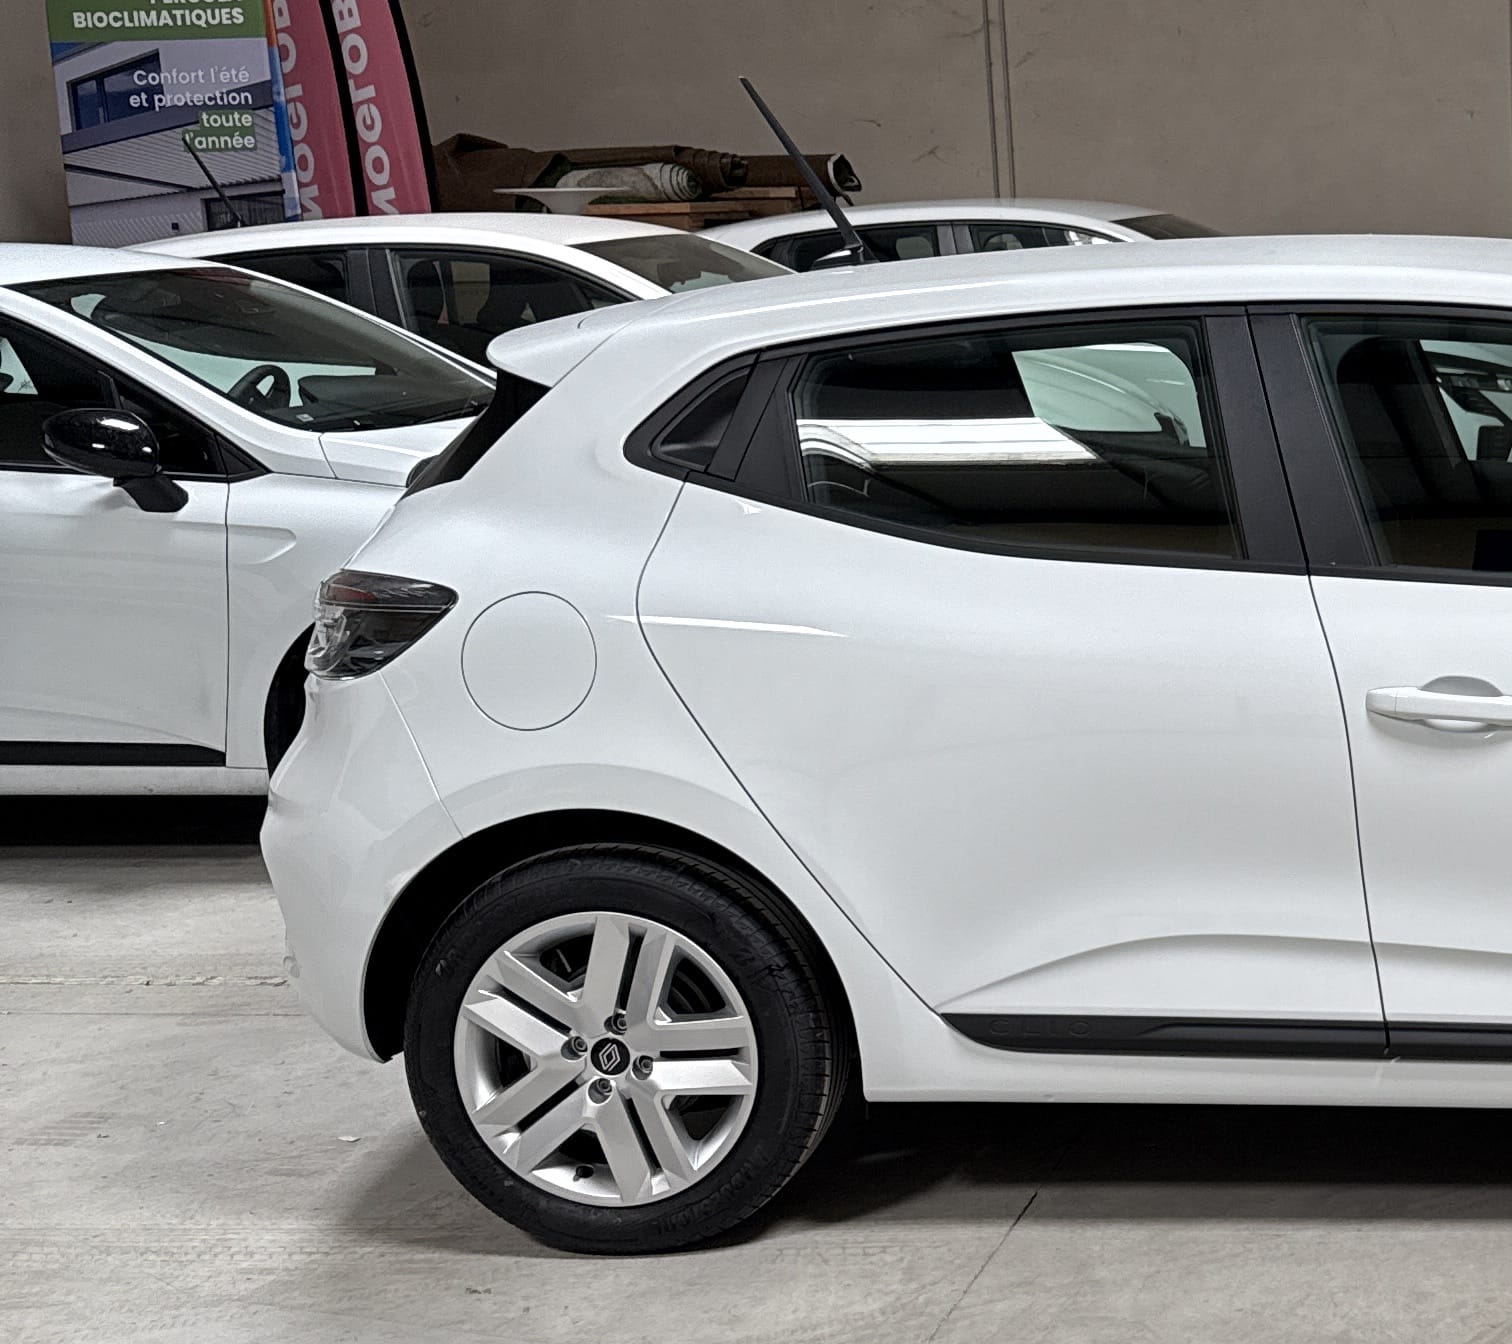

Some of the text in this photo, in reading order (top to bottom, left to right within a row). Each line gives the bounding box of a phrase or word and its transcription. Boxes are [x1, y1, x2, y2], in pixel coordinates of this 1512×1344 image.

[72, 6, 245, 29] BIOCLIMATIQUES
[133, 64, 250, 87] Confort l'été
[128, 88, 253, 112] et protection
[201, 111, 253, 128] toute
